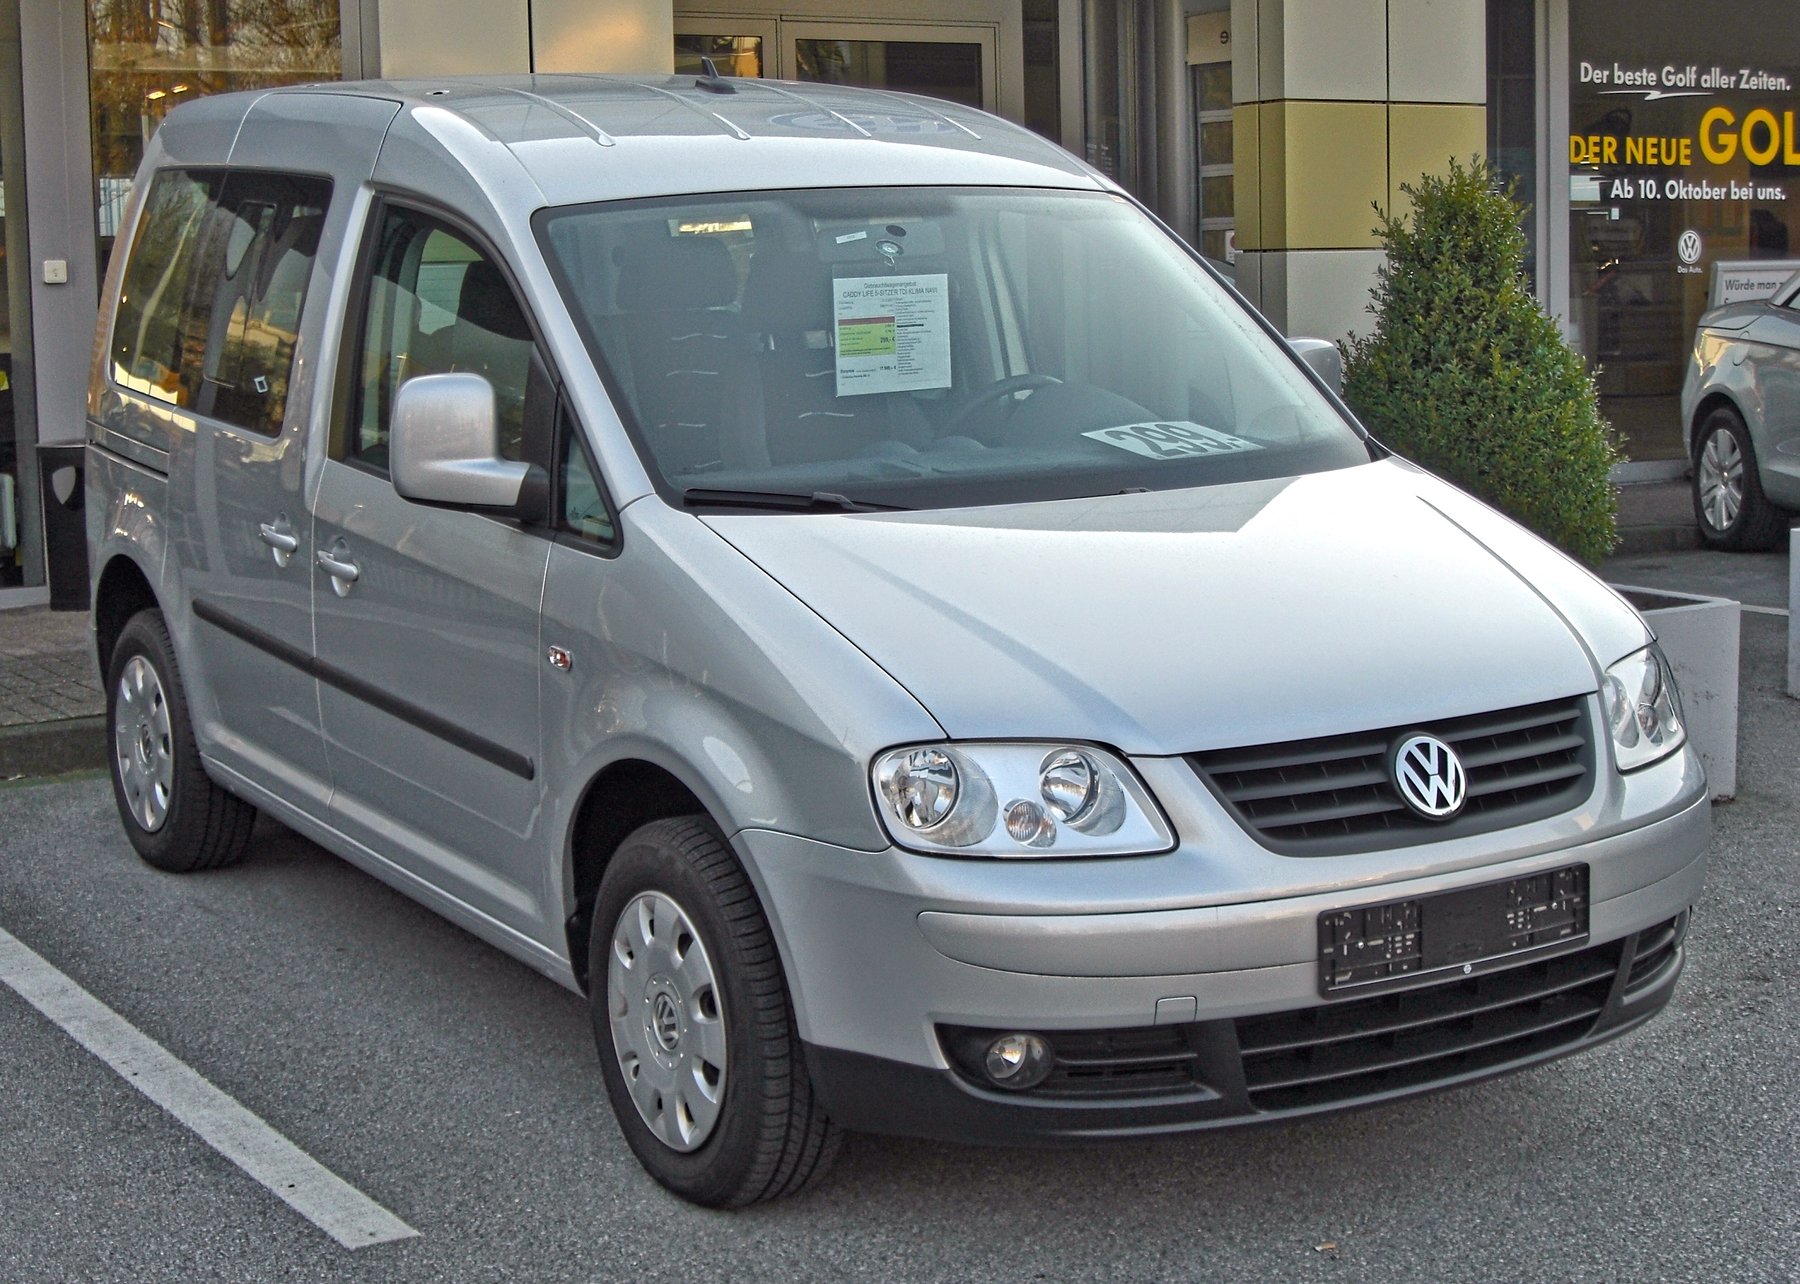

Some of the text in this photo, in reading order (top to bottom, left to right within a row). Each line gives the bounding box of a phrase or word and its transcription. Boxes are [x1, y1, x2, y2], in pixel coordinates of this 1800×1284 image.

[1220, 31, 1229, 45] 9
[1580, 62, 1791, 91] Der beste Golf aller Zeiten.
[1569, 135, 1618, 164] DER
[1626, 136, 1691, 166] NEUE
[1611, 179, 1786, 200] Ab 10. Oktober bei uns.
[1678, 230, 1702, 265] VW
[1677, 265, 1688, 274] Das
[1724, 279, 1755, 291] Würde
[1757, 281, 1777, 290] man
[1395, 735, 1466, 816] VW
